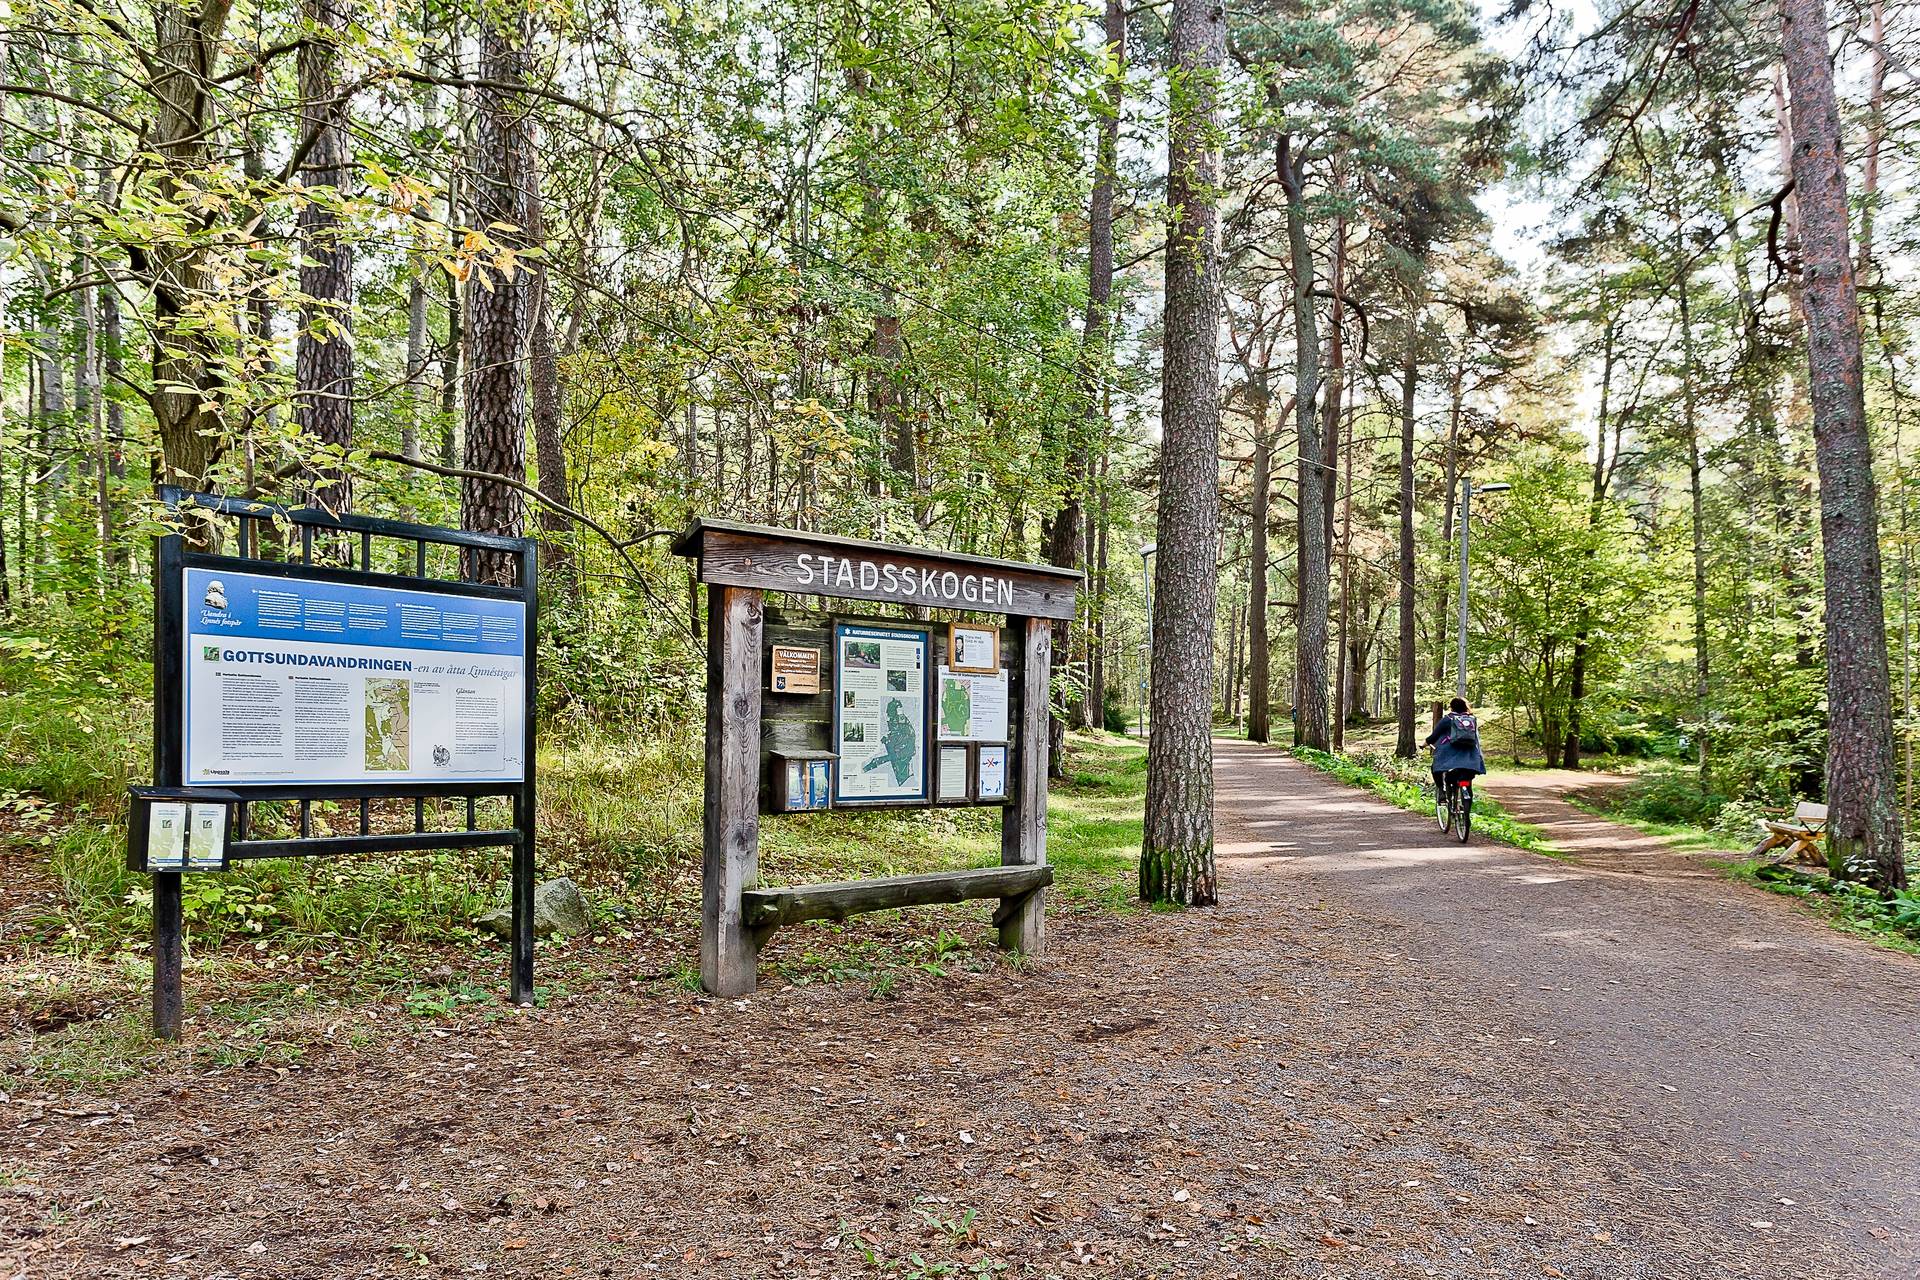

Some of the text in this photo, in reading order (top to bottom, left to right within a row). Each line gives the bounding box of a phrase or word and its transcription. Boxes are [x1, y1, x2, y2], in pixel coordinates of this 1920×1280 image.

[797, 554, 1013, 606] STADSSKOGEN
[223, 649, 412, 672] GOTTSUNDAVANDRINGEN
[432, 665, 446, 674] av
[447, 664, 466, 675] åtta
[468, 665, 518, 680] Linnéstigar
[779, 650, 815, 659] VÄLKOMMEN
